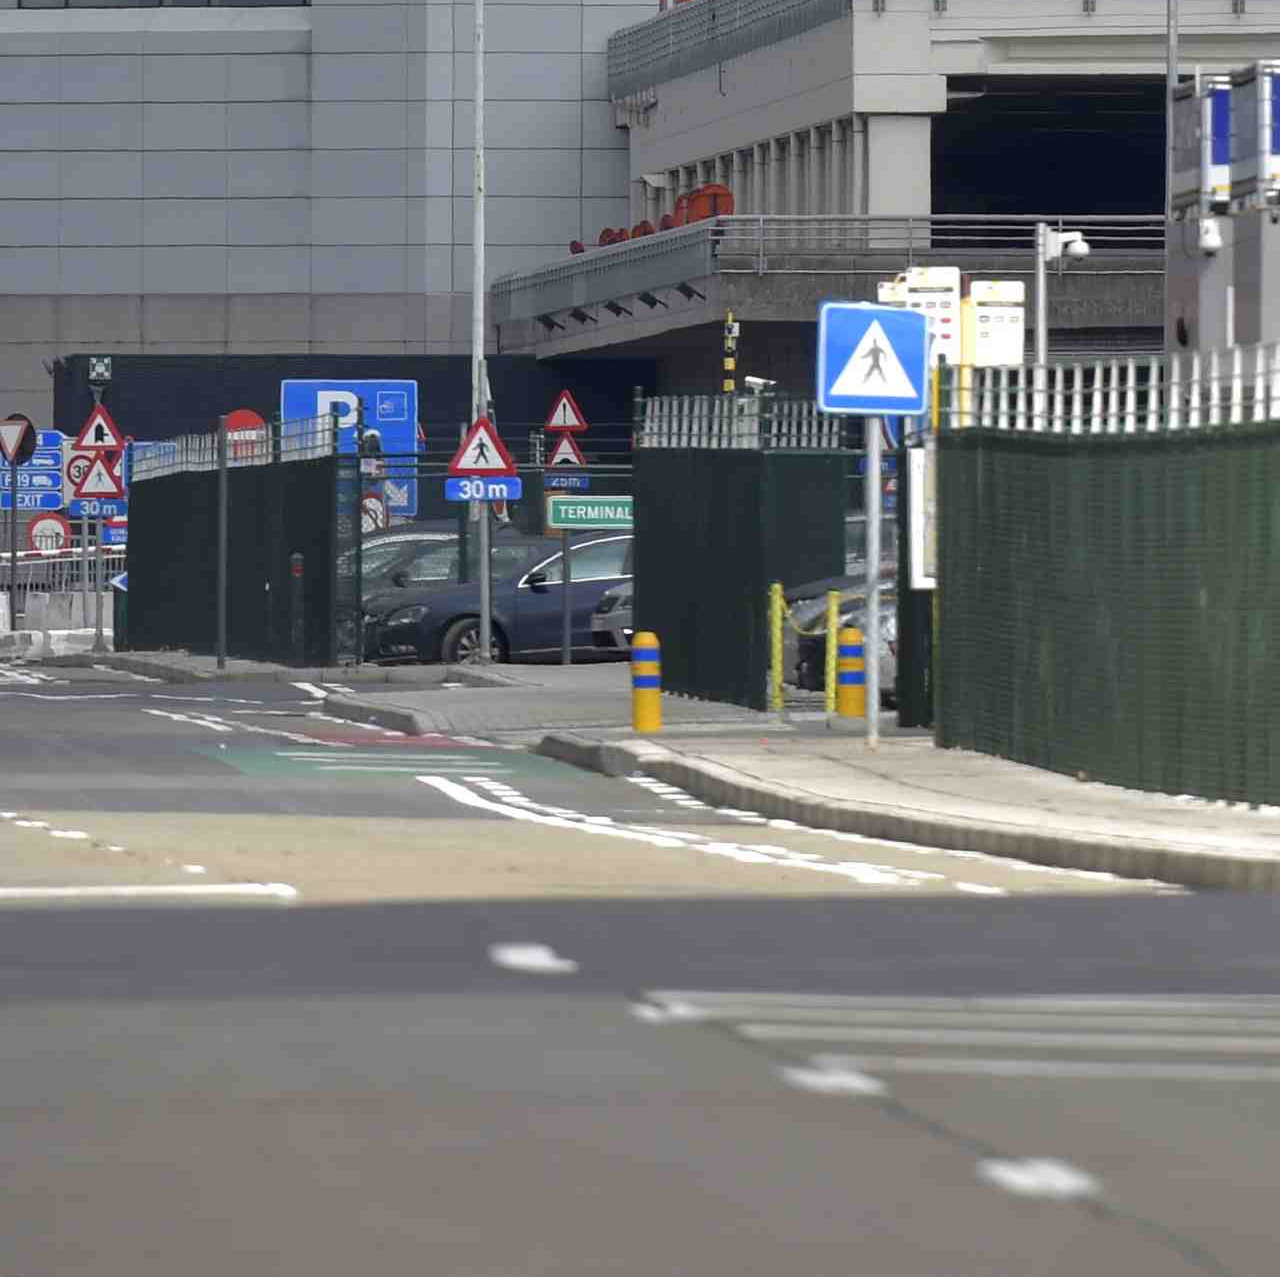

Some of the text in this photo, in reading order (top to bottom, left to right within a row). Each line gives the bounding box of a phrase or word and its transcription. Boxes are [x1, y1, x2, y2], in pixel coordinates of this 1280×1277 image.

[316, 390, 360, 428] P
[458, 480, 508, 499] 30 m
[17, 493, 43, 507] EXIT
[80, 501, 118, 515] 30 m
[560, 505, 634, 520] TERMINAL
